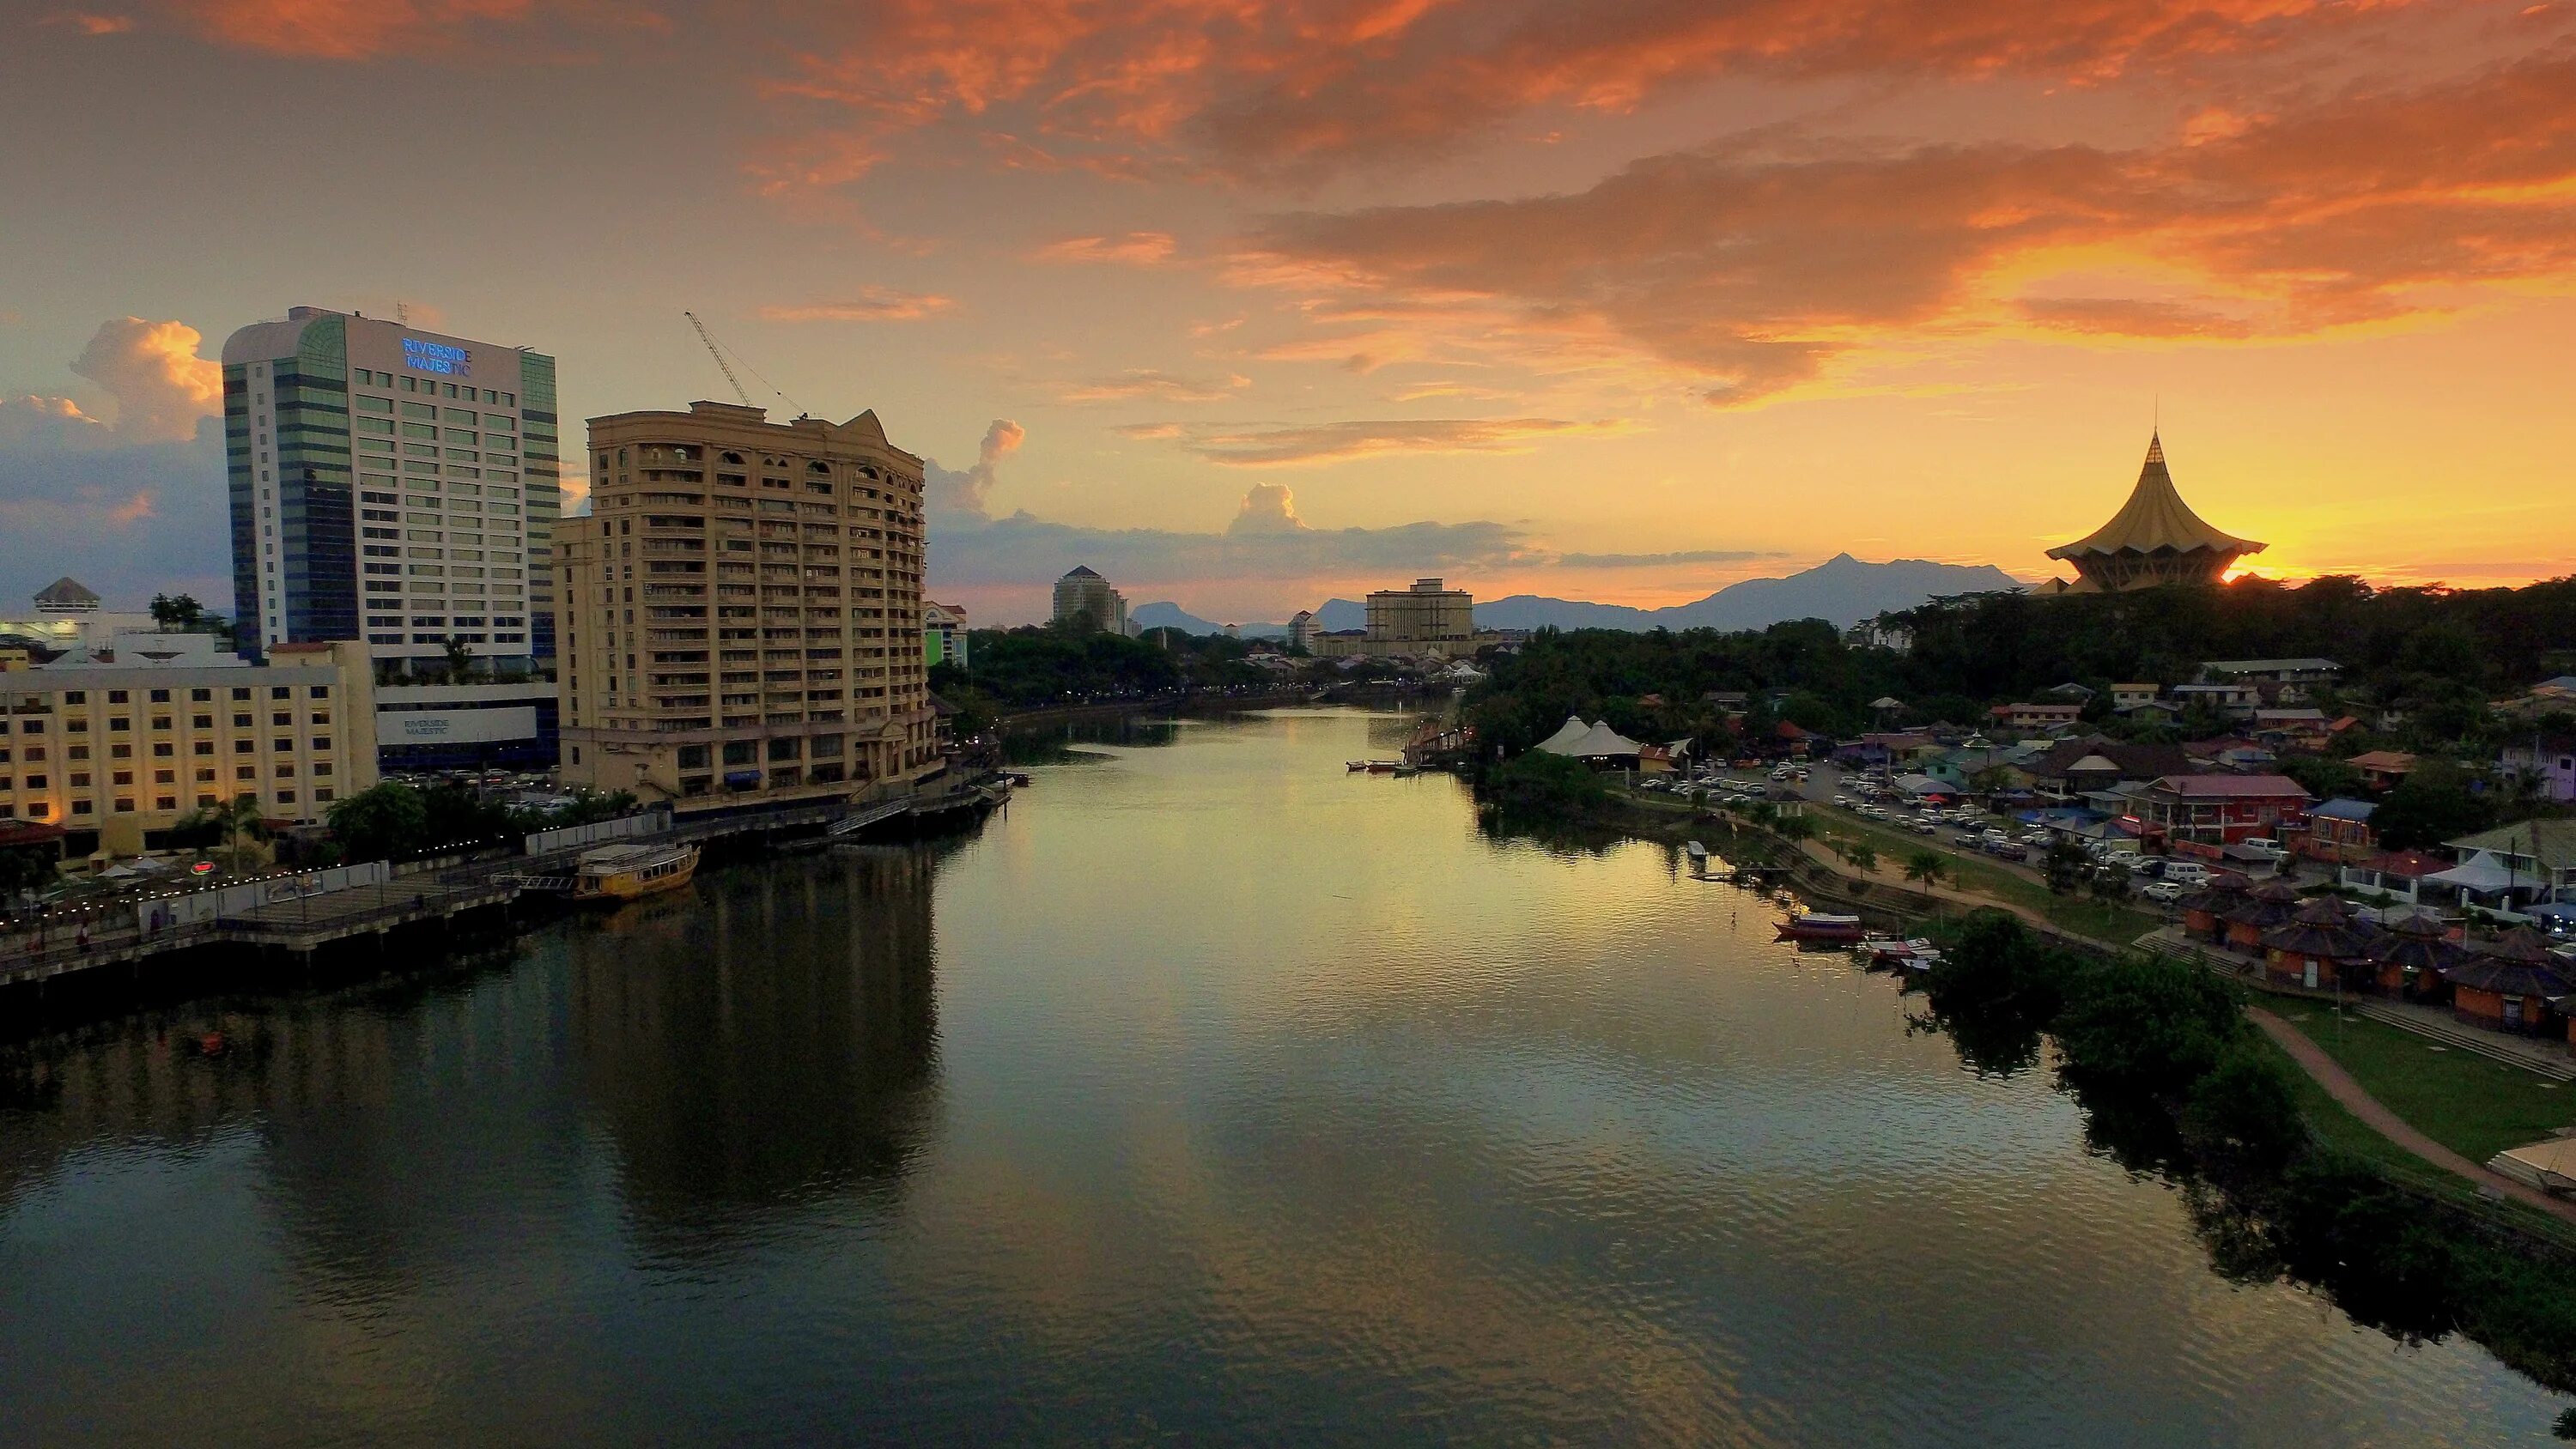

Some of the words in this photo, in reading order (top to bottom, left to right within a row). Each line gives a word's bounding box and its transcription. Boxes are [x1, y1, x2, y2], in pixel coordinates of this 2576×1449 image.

[402, 337, 471, 362] RIVERSIDE
[406, 355, 471, 376] MAJESTIC
[404, 719, 449, 728] RIVERSIDE
